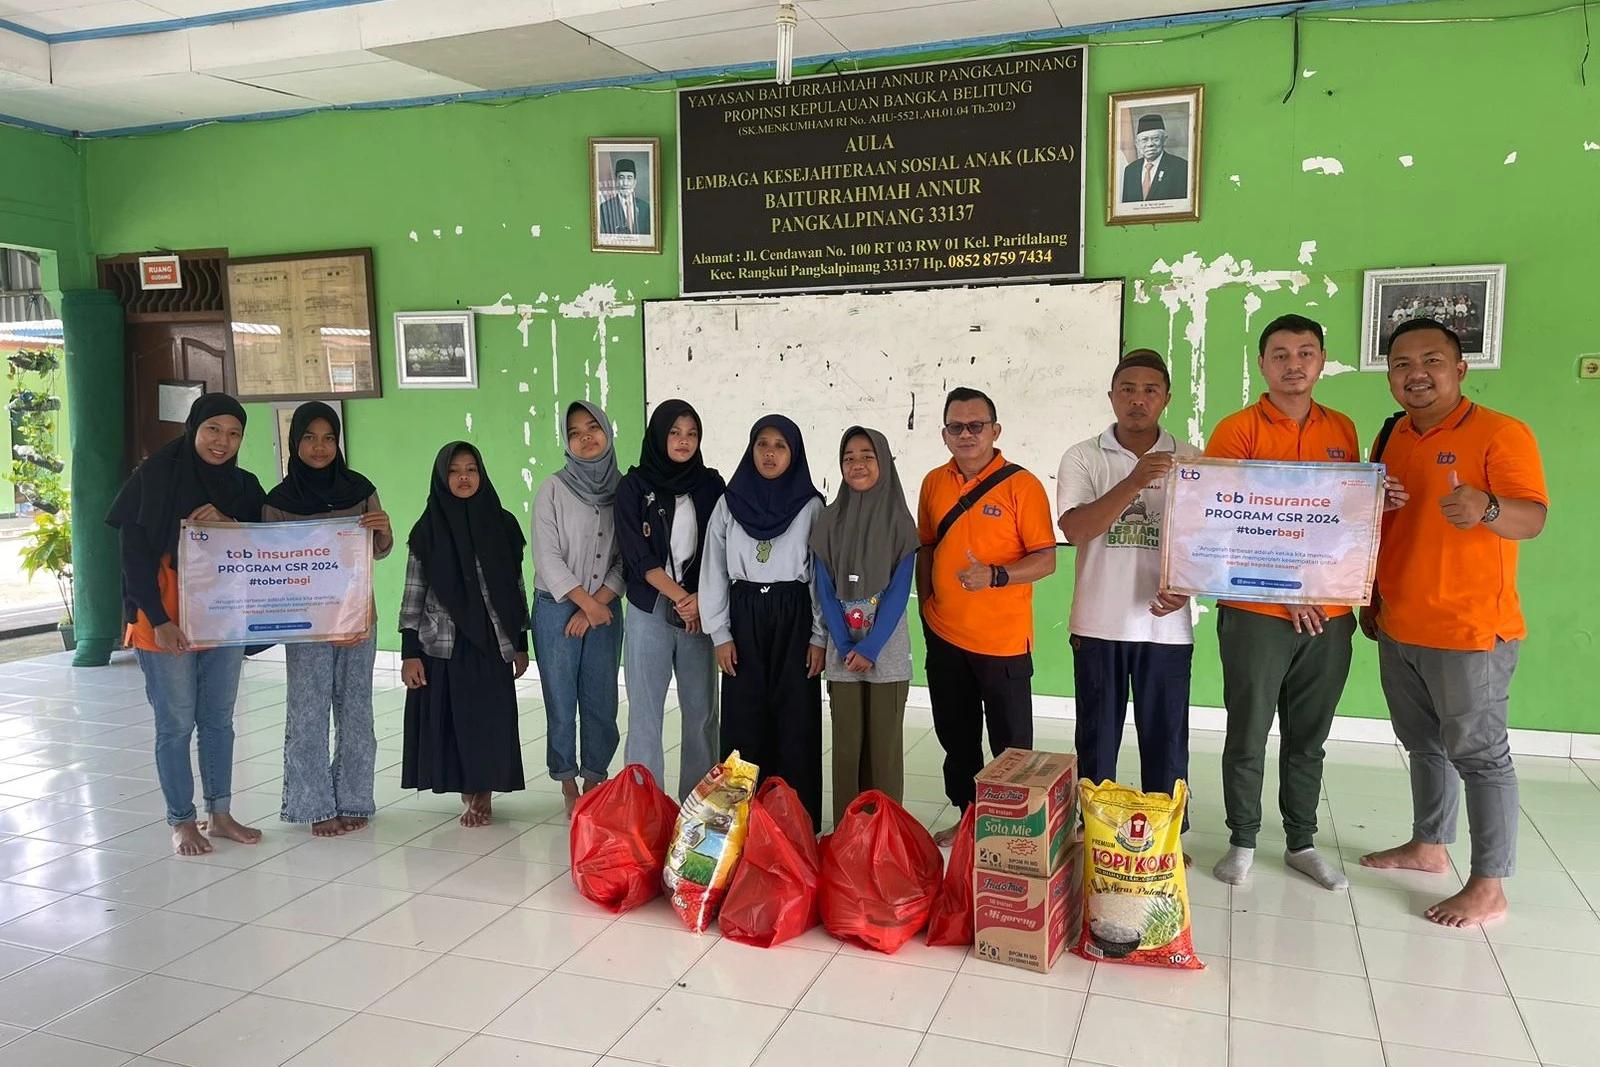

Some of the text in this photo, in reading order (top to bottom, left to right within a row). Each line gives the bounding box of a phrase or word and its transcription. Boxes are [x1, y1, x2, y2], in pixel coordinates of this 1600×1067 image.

[688, 55, 1077, 108] YAYASAN BAITURRAHMAH ANNUR PANGKALPINANG
[724, 80, 1032, 122] PROPINSI KEPULAUAN BANGKA BELITUNG
[836, 117, 847, 127] RI
[850, 115, 867, 126] No.
[971, 100, 1016, 115] Th.2012)
[845, 133, 895, 153] AULA
[686, 145, 1075, 191] LEMBAGA KESEJAHTERAAN SOSIAL ANAK (LKSA)
[765, 177, 982, 209] BAITURRAHMAH ANNUR
[771, 204, 975, 233] PANGKALPINANG 33137
[692, 252, 733, 265] Alamat
[743, 249, 757, 262] Jl.
[760, 247, 822, 261] Cendawan
[826, 245, 847, 258] No.
[850, 243, 871, 256] 100
[874, 241, 895, 255] RT
[897, 240, 913, 253] 03
[916, 238, 942, 252] RW
[945, 237, 959, 250] 01
[964, 236, 989, 249] Kel.
[993, 232, 1067, 247] Paritlalang
[148, 265, 172, 273] RUANG
[710, 269, 735, 281] Kec.
[738, 264, 788, 280] Rangkui
[791, 260, 880, 278] Pangkalpinang
[883, 258, 919, 272] 33137
[948, 254, 980, 268] 0852
[983, 251, 1016, 266] 8759
[1019, 249, 1052, 264] 7434
[1180, 469, 1200, 481] tob
[1216, 491, 1331, 508] tob insurance
[1205, 508, 1340, 525] PROGRAM CSR 2024
[190, 531, 209, 542] tob
[1236, 526, 1305, 540] #toberbagi
[226, 547, 331, 560] tob insurance
[218, 561, 339, 574] PROGRAM CSR 2024
[249, 576, 311, 586] #toberbagi
[1011, 824, 1032, 837] Mie
[1091, 838, 1116, 849] PREMIUM
[1092, 847, 1131, 873] TOPI
[1110, 883, 1133, 894] Beras
[1001, 914, 1037, 929] goreng
